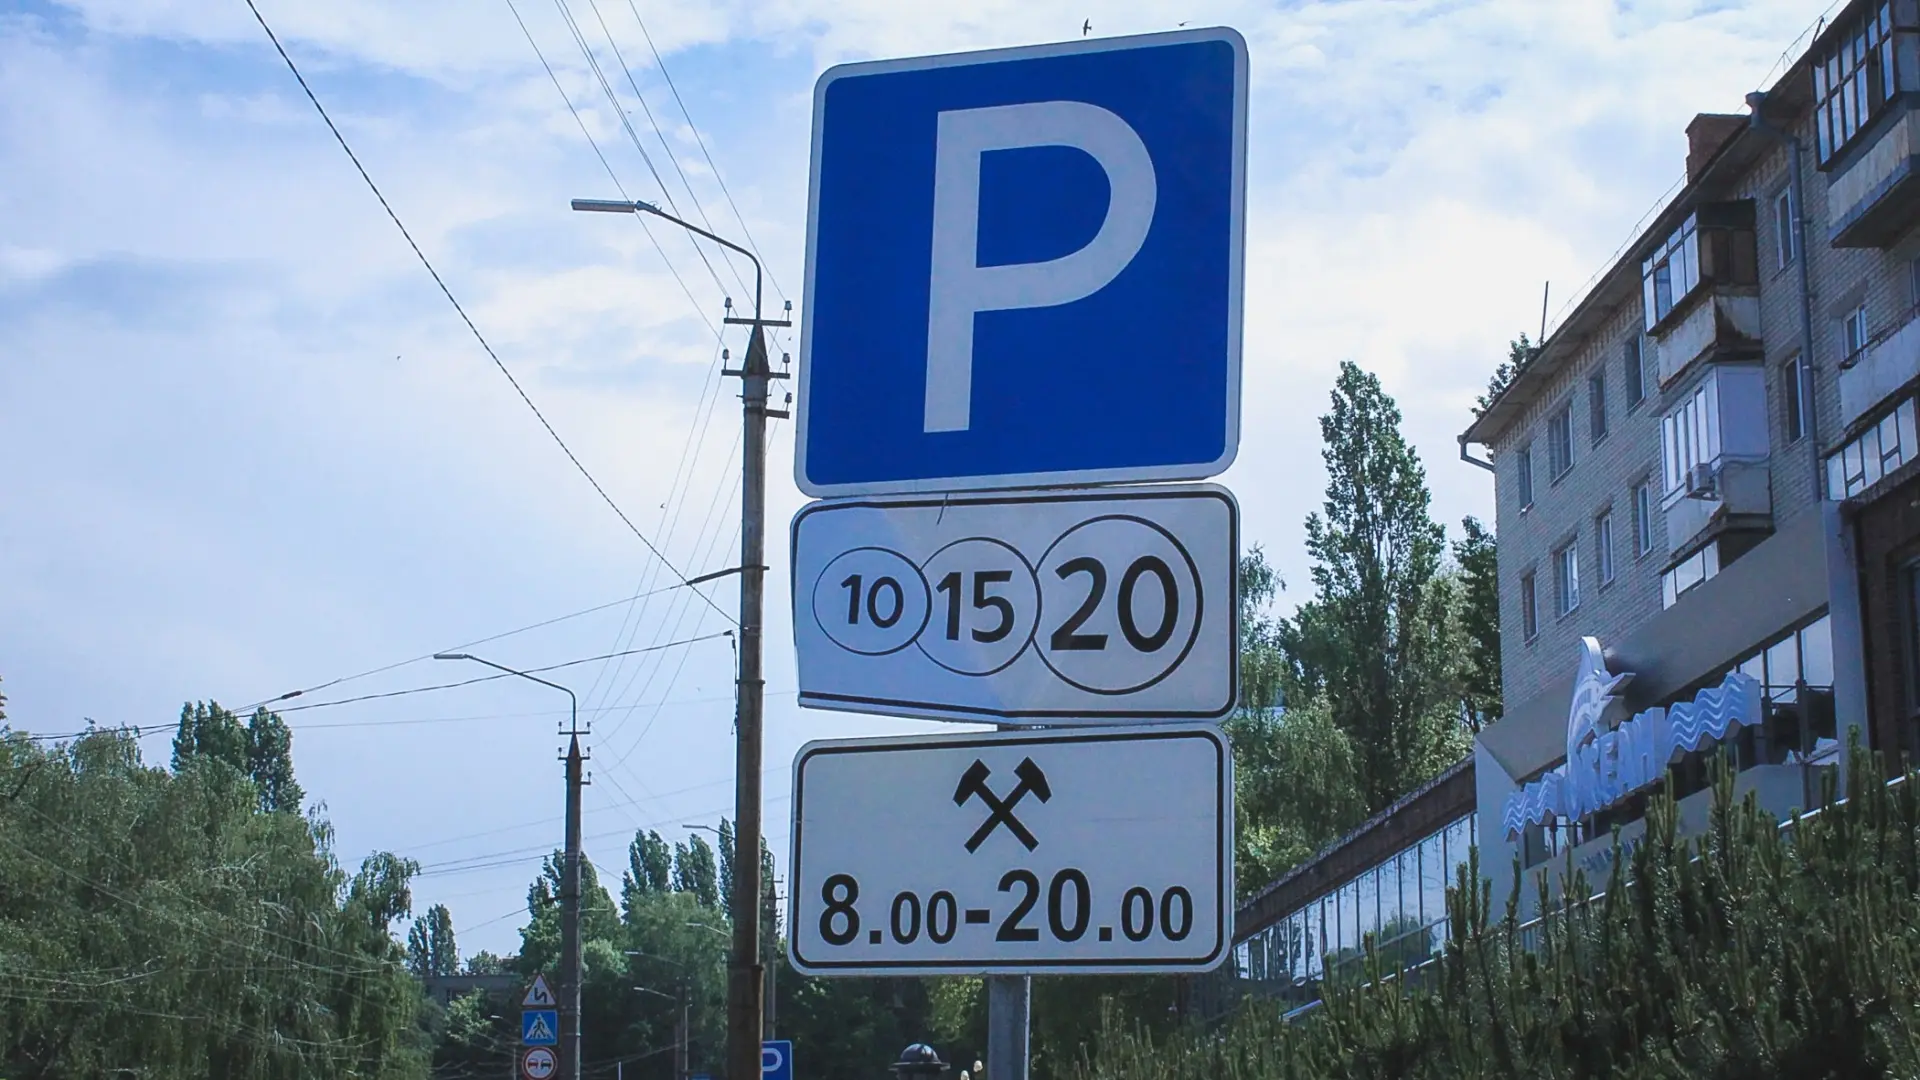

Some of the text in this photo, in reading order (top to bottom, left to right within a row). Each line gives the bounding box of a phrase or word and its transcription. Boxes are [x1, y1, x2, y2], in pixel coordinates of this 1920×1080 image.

[923, 100, 1157, 433] P
[840, 556, 1179, 653] 10 15 20
[818, 868, 1193, 945] 8.00-20.00
